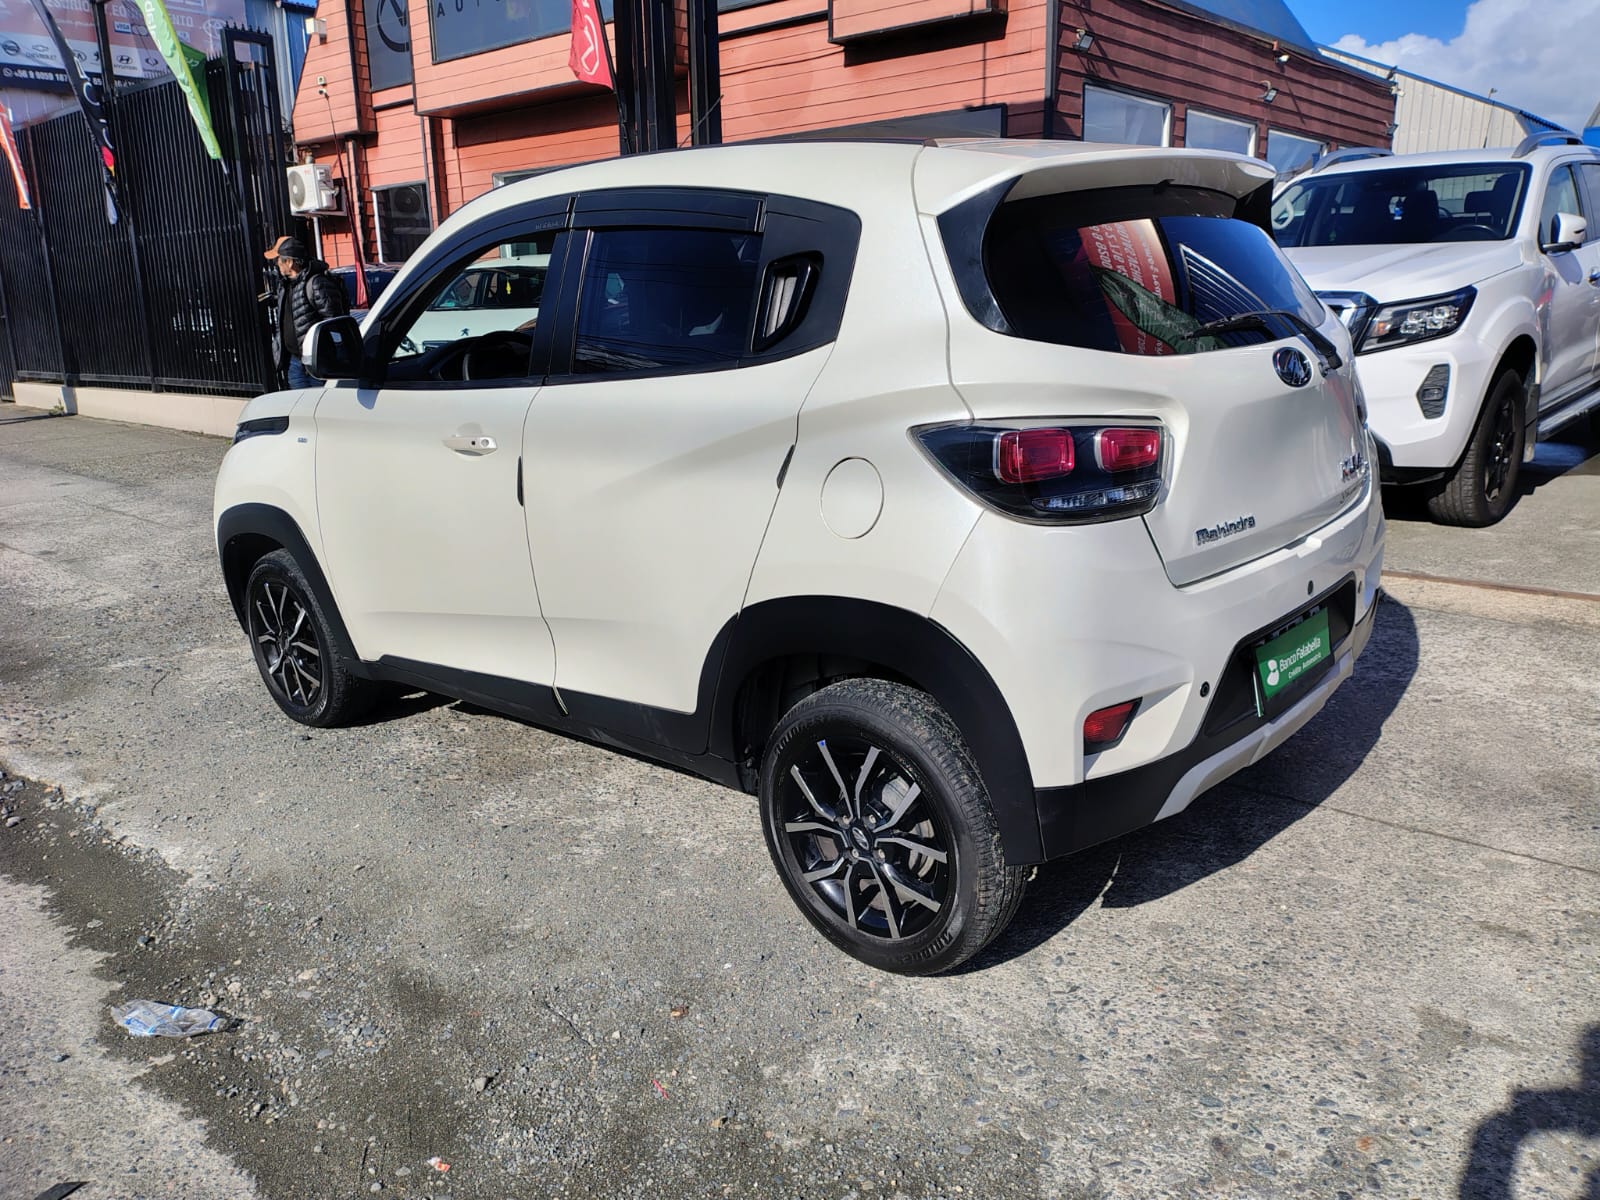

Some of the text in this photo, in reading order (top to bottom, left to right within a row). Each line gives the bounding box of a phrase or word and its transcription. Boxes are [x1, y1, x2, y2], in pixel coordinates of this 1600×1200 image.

[1196, 515, 1256, 546] Mahindra
[1279, 636, 1321, 672] Banco Falabella
